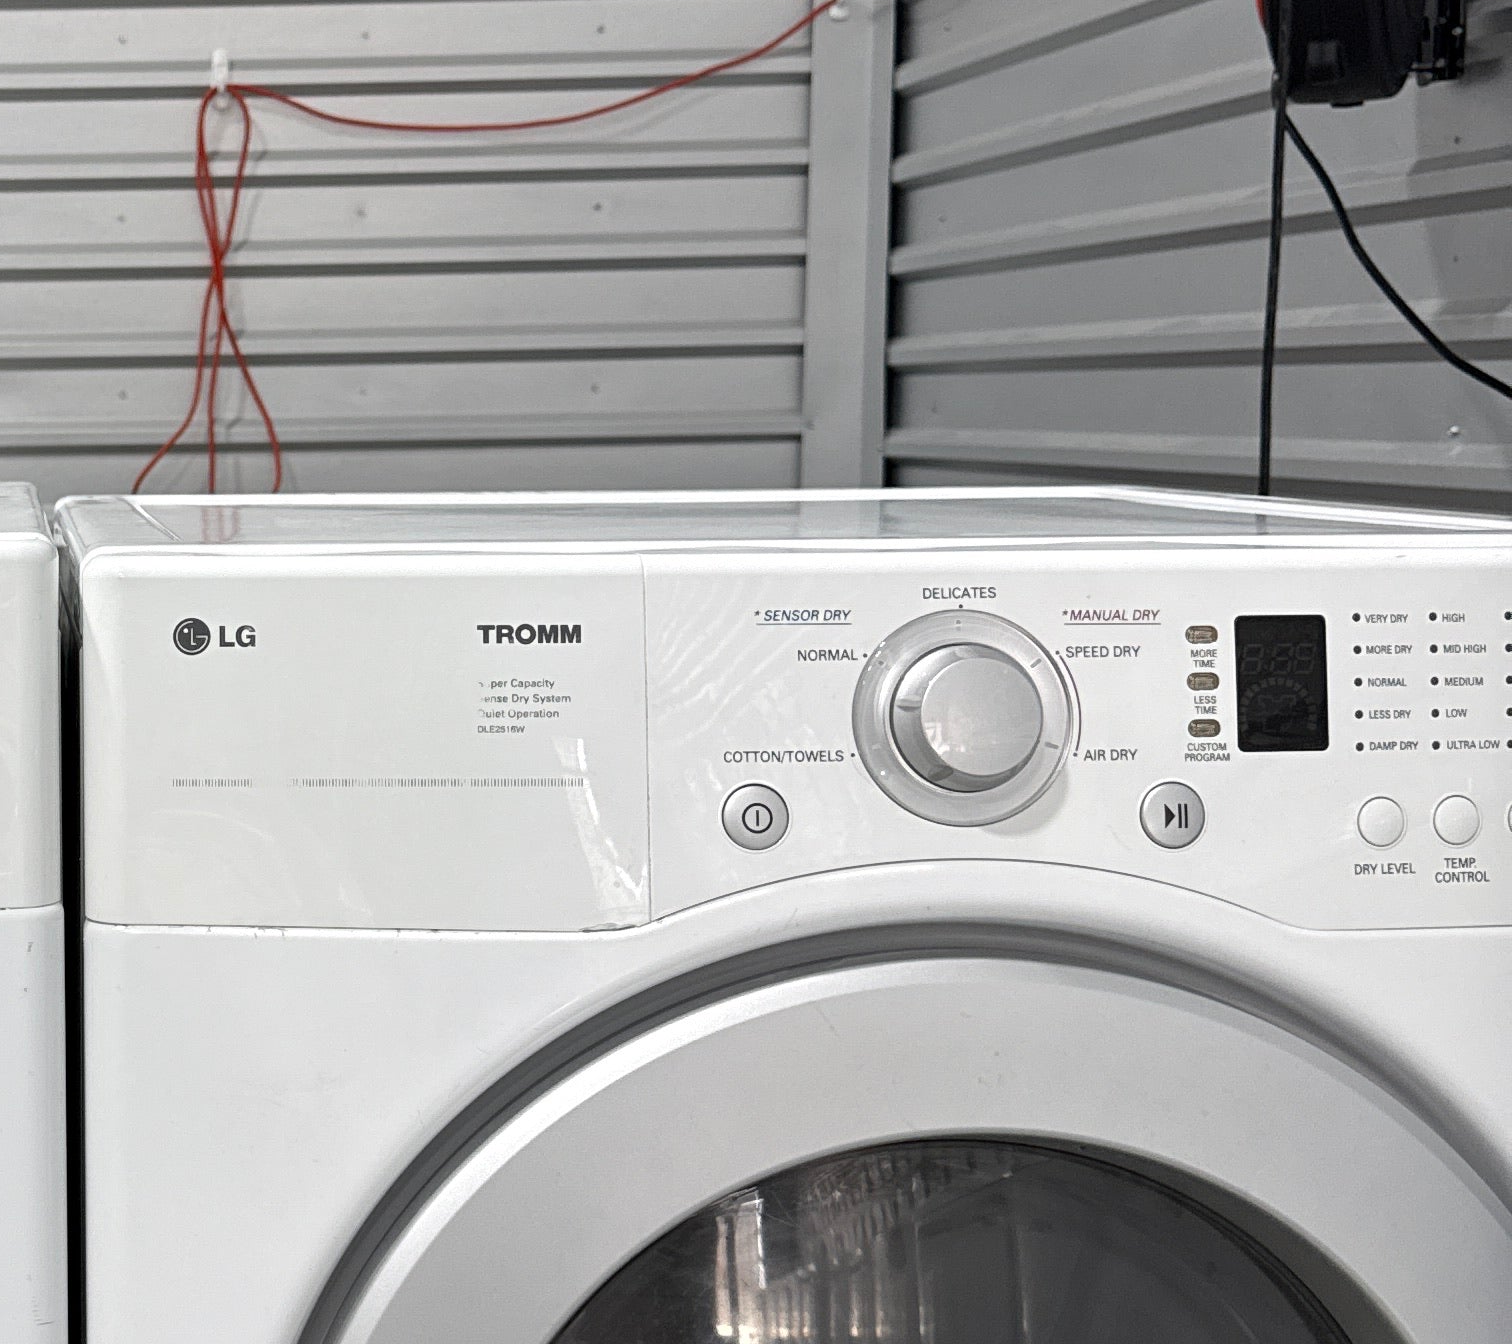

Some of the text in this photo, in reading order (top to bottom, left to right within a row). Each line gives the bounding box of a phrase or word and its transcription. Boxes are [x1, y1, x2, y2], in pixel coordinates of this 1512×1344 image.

[922, 587, 997, 600] DELICATES
[763, 609, 851, 622] SENSOR DRY
[1132, 609, 1160, 621] DRY
[1364, 614, 1409, 624] VERY DRY
[1442, 613, 1465, 623] HIGH
[219, 625, 256, 647] LG
[476, 623, 582, 645] TROMM
[1065, 646, 1141, 658] SPEED DRY
[1190, 649, 1218, 658] MORE
[1365, 645, 1413, 655] MORE DRY
[1443, 644, 1487, 654] MID HIGH
[797, 649, 858, 662] NORMAL
[1193, 659, 1216, 668] TIME
[478, 678, 555, 690] per Capacity
[1367, 677, 1407, 688] NORMAL
[1444, 677, 1484, 687] MEDIUM
[481, 694, 572, 705] ense Dry System
[1193, 696, 1217, 705] LESS
[507, 708, 560, 720] Operation
[1195, 705, 1218, 714] TIME
[1368, 709, 1412, 720] LESS DRY
[1445, 708, 1468, 718] LOW
[1187, 743, 1227, 752] CUSTOM
[1369, 741, 1419, 752] DAMP DRY
[1446, 740, 1501, 750] ULTRA LOW
[723, 750, 845, 764] COTTON/TOWELS
[1083, 749, 1138, 762] AIR DRY
[1184, 753, 1231, 762] PROGRAM
[1354, 862, 1416, 875] DRY LEVEL
[1443, 857, 1477, 869] TEMP.
[1434, 871, 1491, 884] CONTROL
